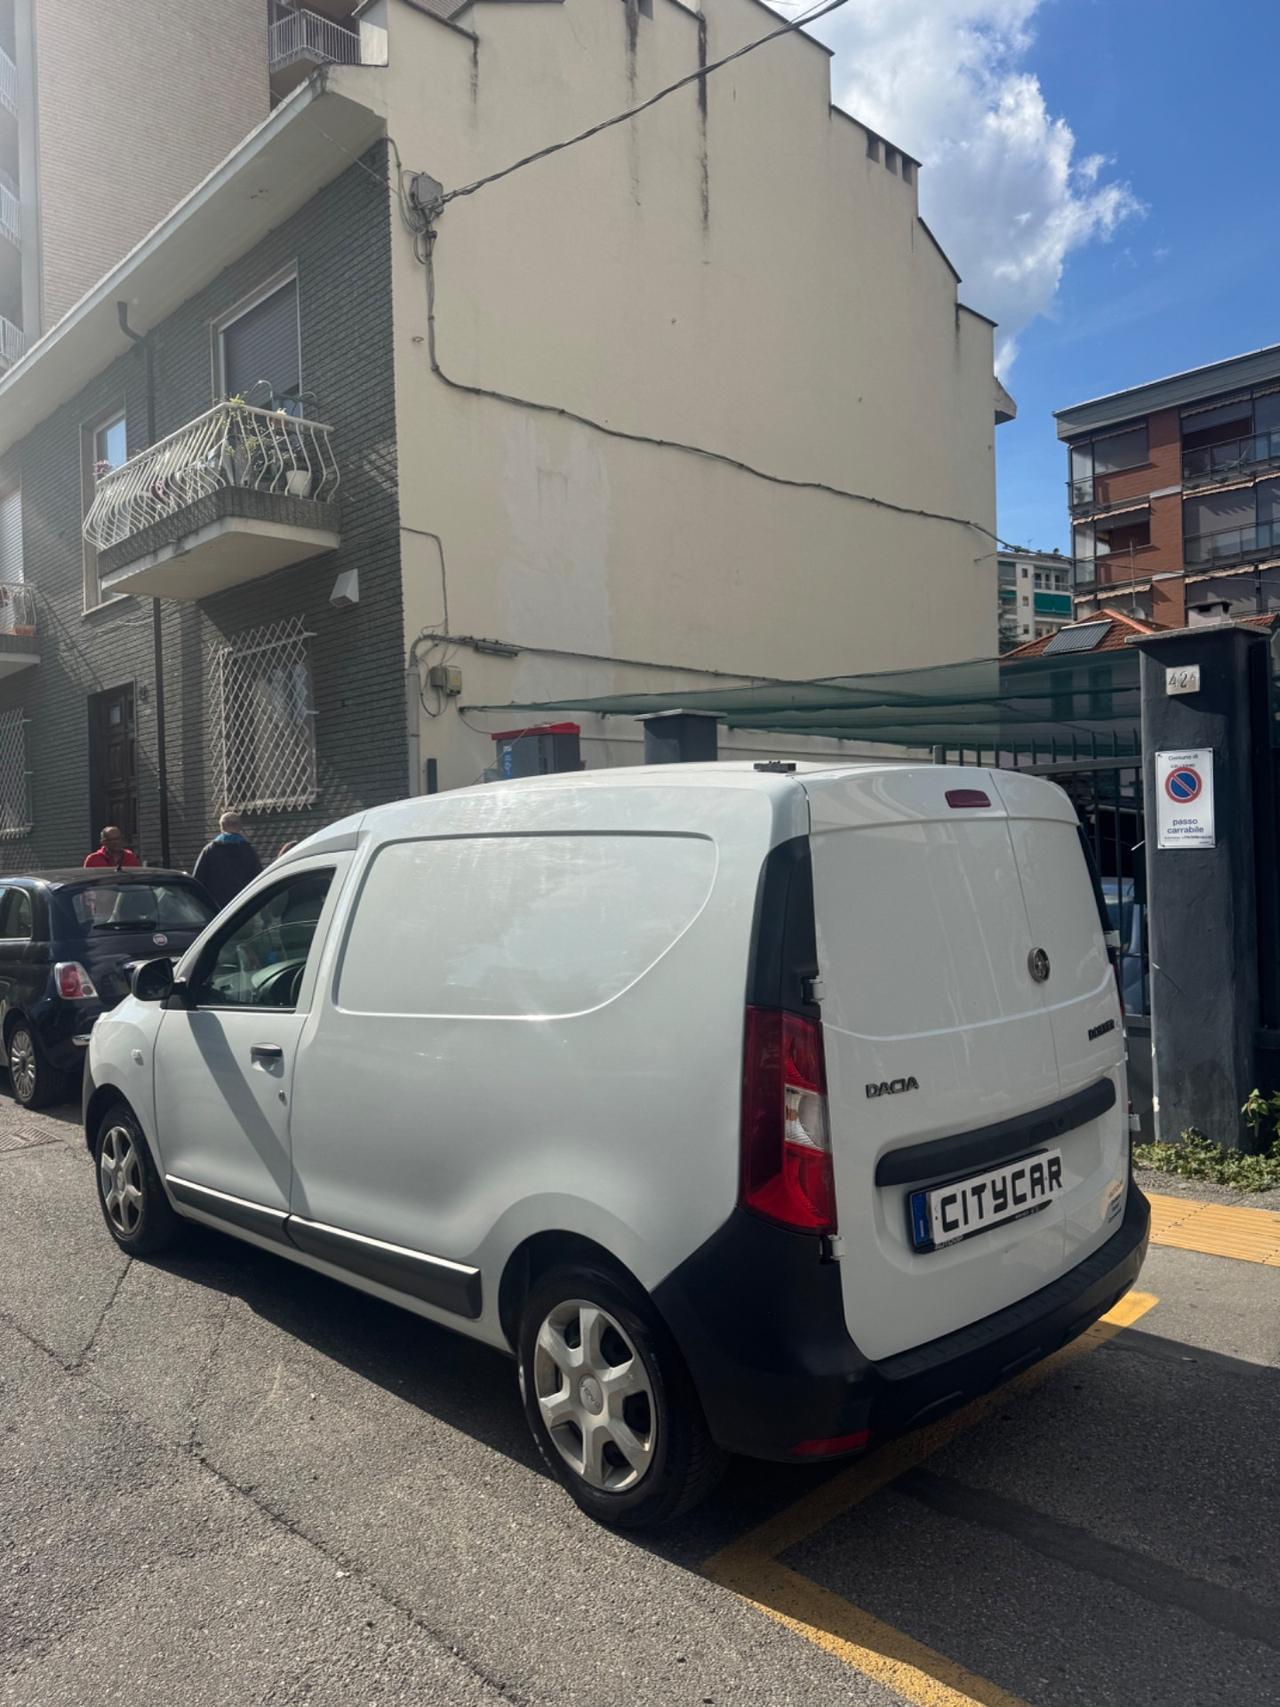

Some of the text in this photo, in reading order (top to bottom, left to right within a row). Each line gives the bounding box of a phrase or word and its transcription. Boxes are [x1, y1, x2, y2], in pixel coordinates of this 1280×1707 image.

[1172, 818, 1198, 826] passo
[1167, 826, 1204, 834] carrabile
[865, 1076, 919, 1098] DACIA
[941, 1156, 1062, 1233] CITYCAR
